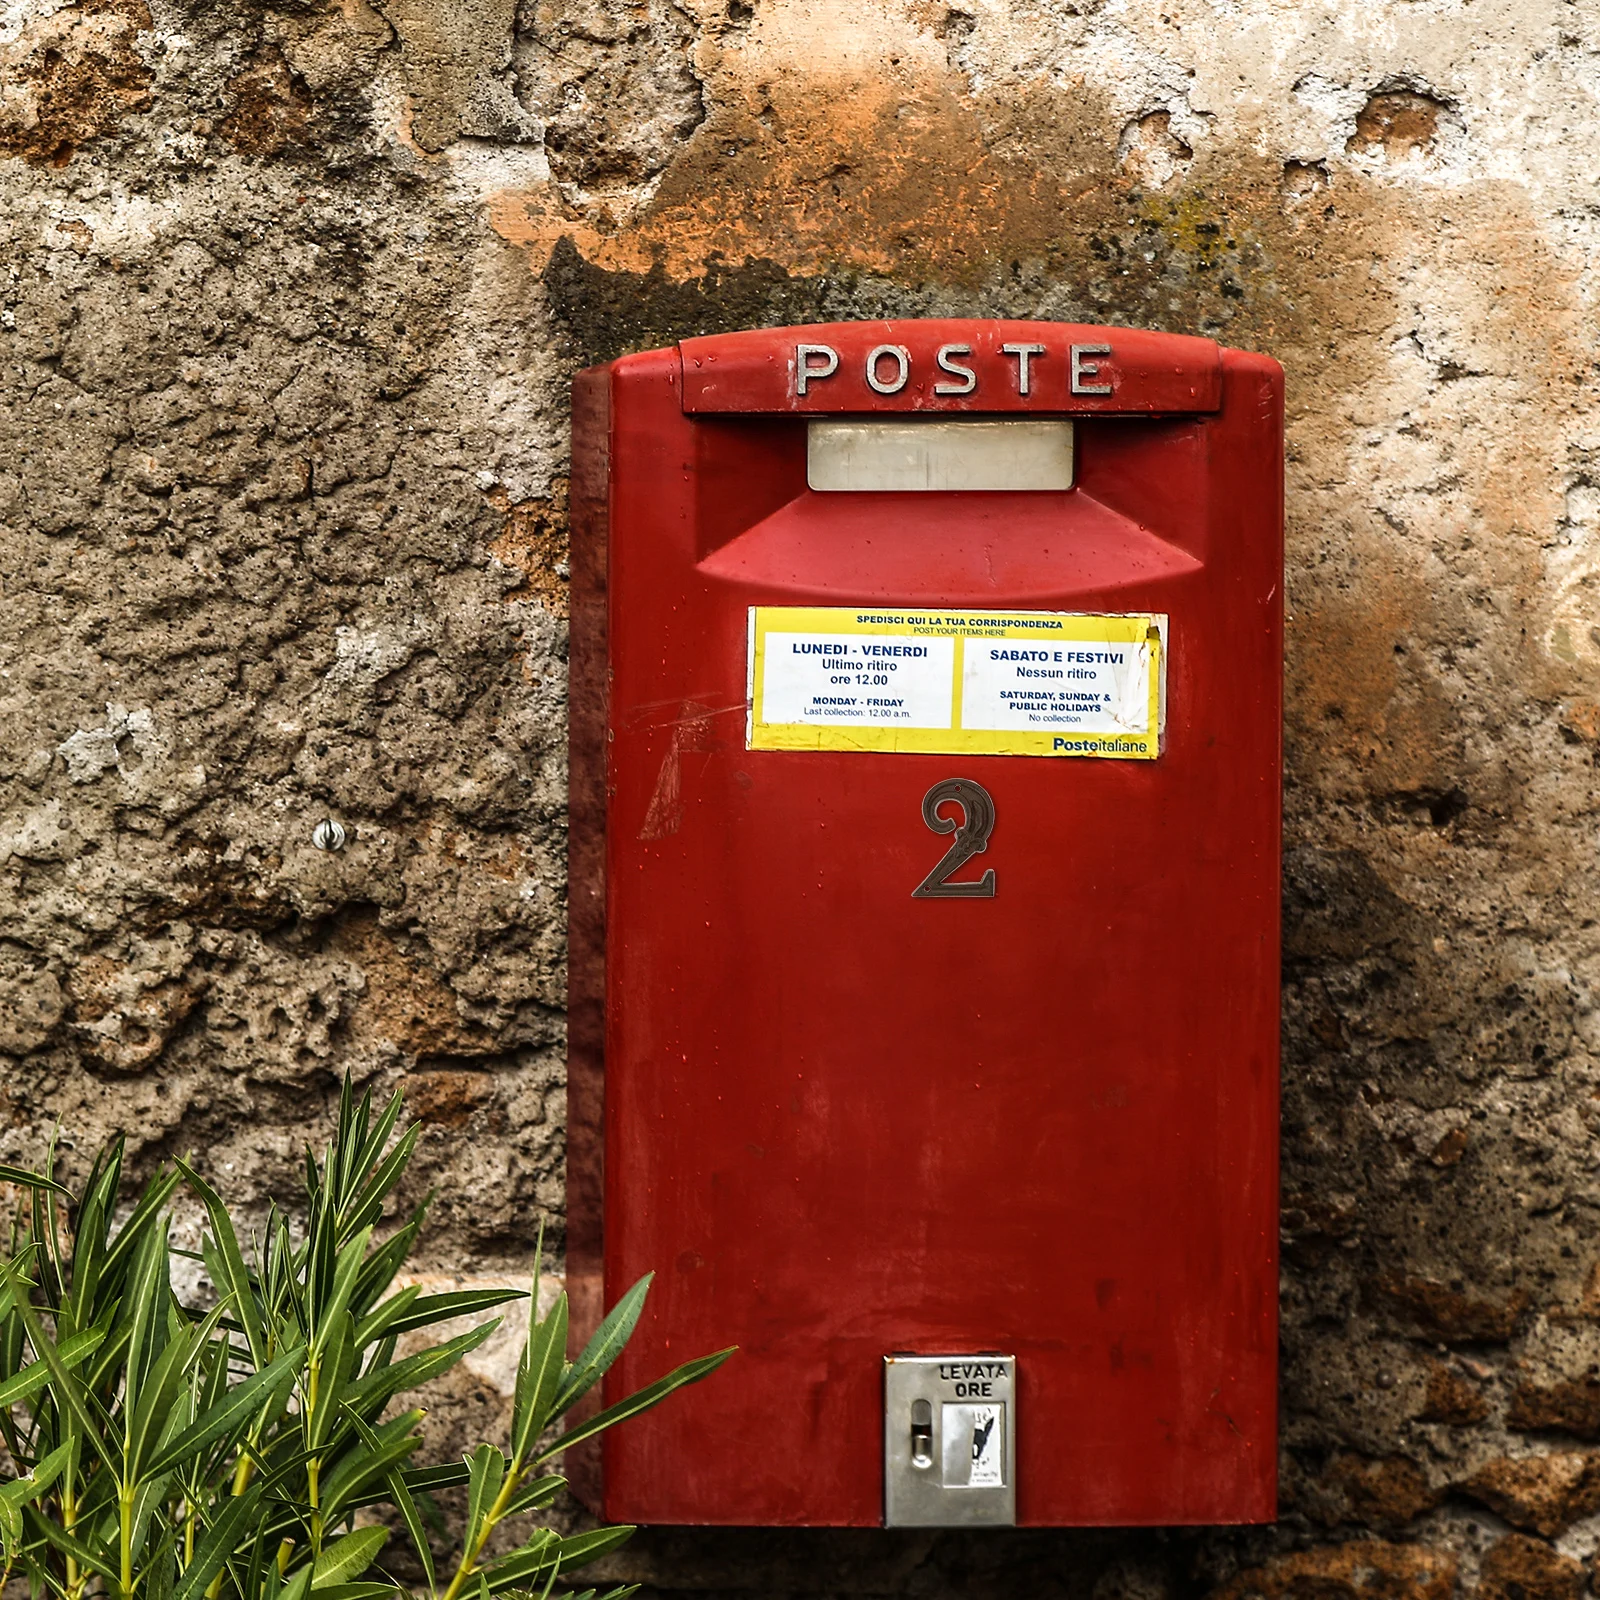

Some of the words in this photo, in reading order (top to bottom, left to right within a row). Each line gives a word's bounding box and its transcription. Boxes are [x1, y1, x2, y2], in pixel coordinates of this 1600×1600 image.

[796, 344, 1113, 395] POSTE
[856, 615, 904, 624] SPEDISCI
[907, 617, 926, 625] QUI
[946, 618, 966, 626] TUA
[969, 618, 1063, 629] CORRISPONDENZA
[960, 628, 984, 636] ITEMS
[792, 643, 848, 655] LUNEDI
[862, 645, 927, 657] VENERDI
[990, 649, 1049, 662] SABATO
[1053, 651, 1062, 663] E
[1067, 652, 1124, 664] FESTIVI
[822, 658, 863, 671] Ultimo
[867, 659, 897, 671] ritiro
[1016, 666, 1063, 679] Nessun
[1067, 668, 1097, 679] ritiro
[830, 676, 850, 685] ore
[855, 675, 888, 686] 12.00
[812, 697, 857, 706] MONDAY
[866, 698, 904, 707] FRIDAY
[999, 691, 1056, 701] SATURDAY,
[1059, 692, 1100, 701] SUNDAY
[1103, 694, 1112, 702] &
[803, 707, 822, 716] Last
[824, 708, 866, 717] collection:
[868, 709, 891, 718] 12.00
[893, 710, 912, 718] a.m.
[1009, 702, 1048, 711] PUBLIC
[1050, 703, 1101, 712] HOLIDAYS
[1029, 714, 1041, 722] No
[1042, 714, 1081, 723] collection
[1053, 737, 1148, 753] Posteitaliane
[911, 777, 996, 898] 2
[940, 1364, 1008, 1380] LEVATA
[955, 1383, 992, 1397] ORE
